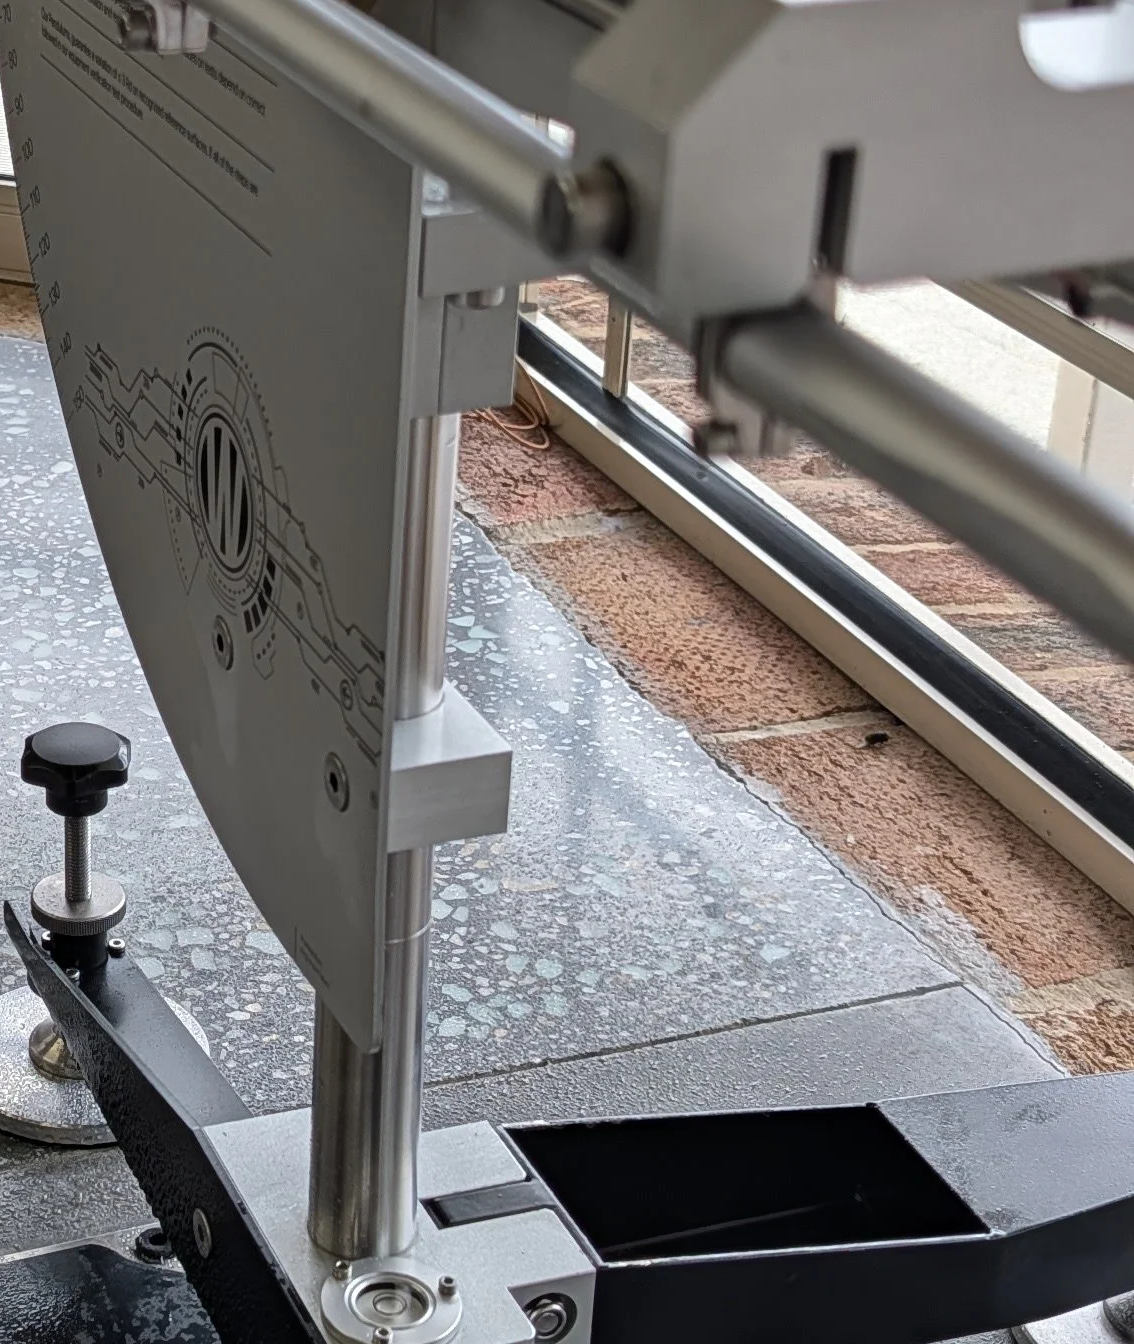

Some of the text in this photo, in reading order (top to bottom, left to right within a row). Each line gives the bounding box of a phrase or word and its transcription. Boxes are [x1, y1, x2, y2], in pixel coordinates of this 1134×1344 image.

[38, 231, 51, 257] 120
[48, 280, 61, 307] 130
[59, 331, 72, 358] 140
